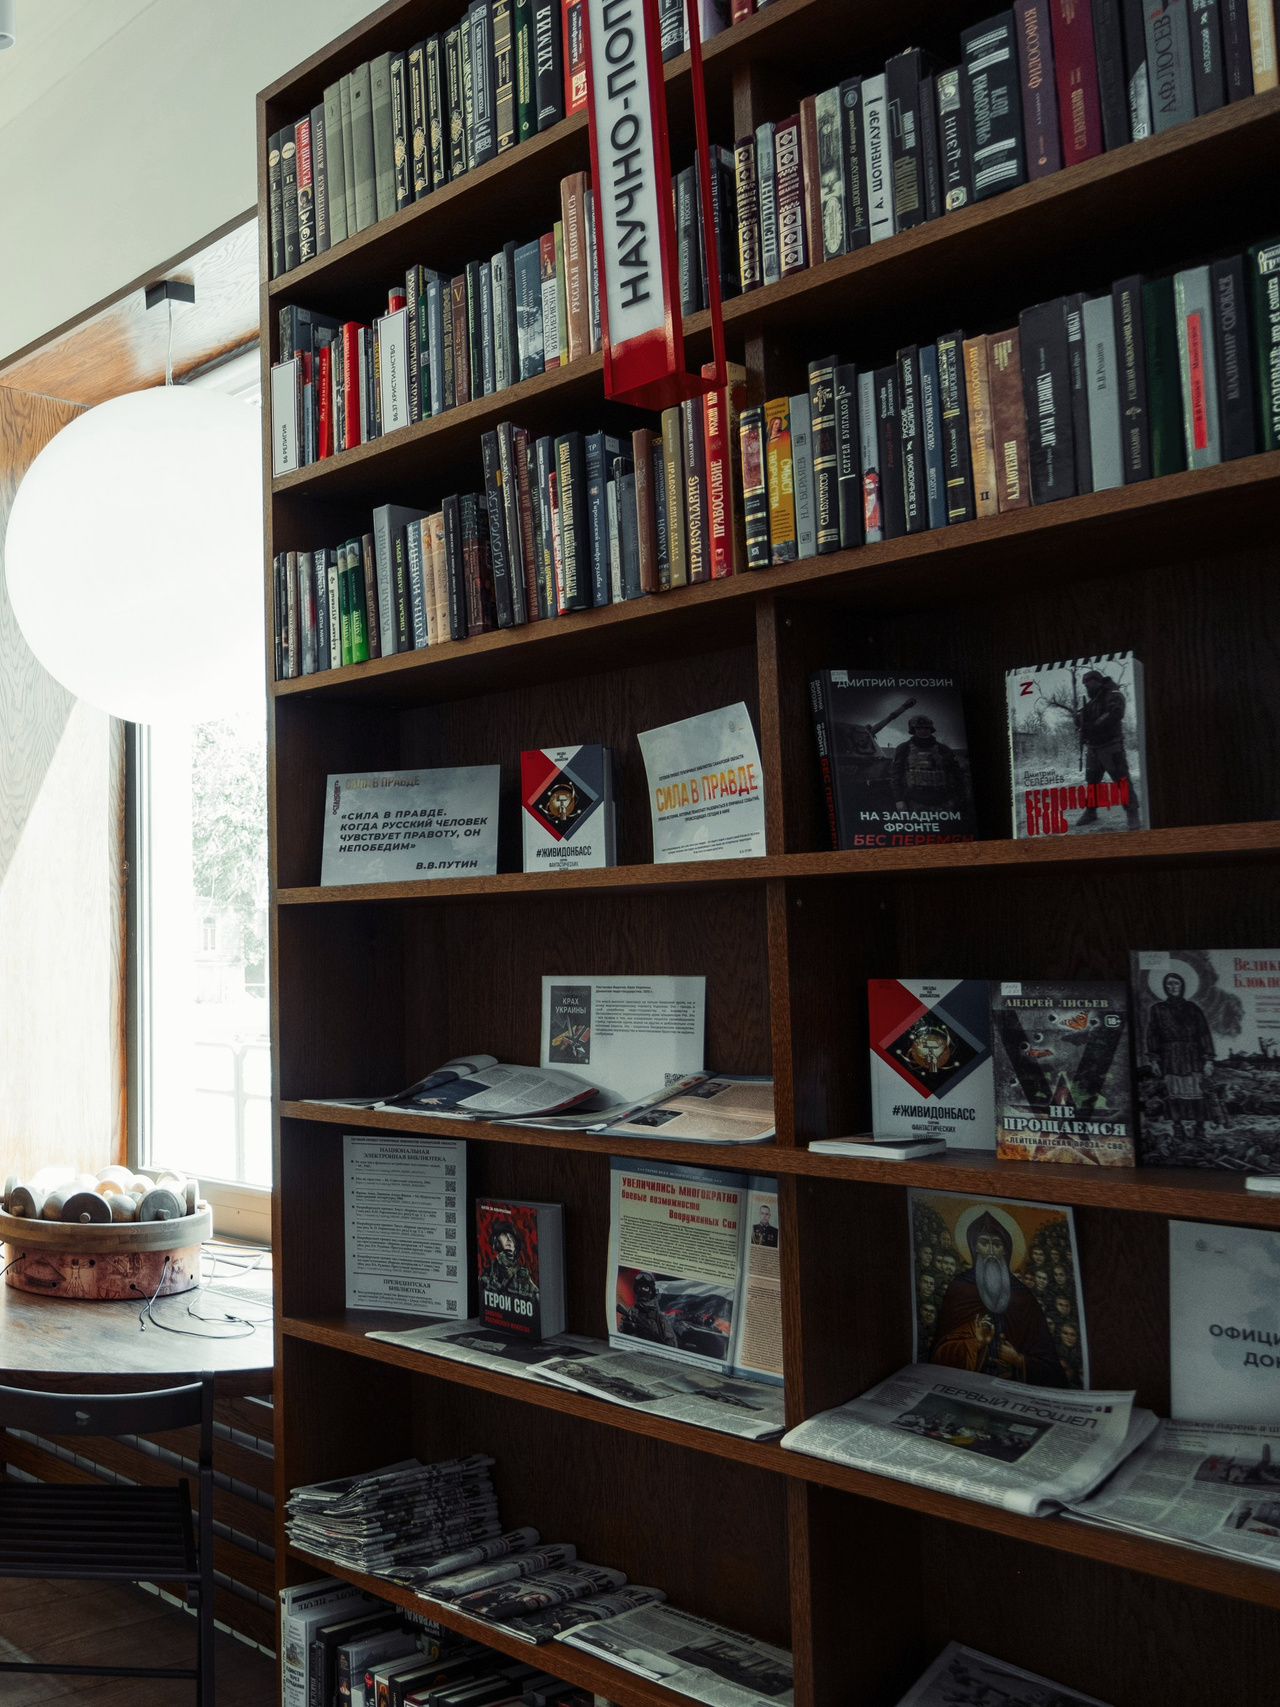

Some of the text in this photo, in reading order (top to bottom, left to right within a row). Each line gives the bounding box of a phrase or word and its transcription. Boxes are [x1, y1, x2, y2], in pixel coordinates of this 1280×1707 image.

[537, 5, 553, 77] ХИМИЯ
[1024, 7, 1043, 89] ФИЛОСОФИЯ
[971, 72, 991, 145] ФИЛОСОФИЯ
[990, 85, 1009, 118] ЙОГИ
[604, 0, 650, 309] НАУЧНО-ПОП
[869, 109, 884, 209] А. ШОПЕНГАУЭР
[944, 115, 962, 183] И-ЦЗИН
[316, 121, 326, 236] ЕВРОПЕЙСКАЯ ЖИВОПИСЬ
[850, 156, 861, 206] ШОПЕНГАУЭР
[760, 179, 775, 255] ШЕЛЛИНГ
[568, 194, 580, 314] РУССКАЯ ИКОНОПИСЬ
[543, 287, 551, 323] ЦАРСТВО
[1267, 276, 1280, 311] contra
[548, 284, 557, 352] ИНКВИЗИЦИЯ:
[1218, 274, 1240, 400] ВЛАДИМИР СОЛОВЬЕВ
[903, 357, 912, 385] ЕВРОПА
[949, 364, 958, 401] МИРОВОЕ
[969, 346, 984, 434] КУРС ФИЛОСОФИИ
[906, 395, 916, 437] МЫСЛИТЕЛИ
[1036, 372, 1057, 447] ЛИСТЫ ДНЕВНИКА
[840, 398, 851, 474] СЕРГЕЙ БУЛГАКОВ
[926, 406, 935, 451] ФИЛОСОФИЯ
[283, 455, 288, 464] 86
[558, 441, 569, 463] РОССИИ
[707, 406, 725, 538] ПРАВОСЛАВИЕ РУССКИЙ
[769, 449, 779, 509] ТВОРЧЕСТВА
[781, 459, 792, 494] СМЫСЛ
[668, 461, 677, 529] ПРАВОСЛАВНАЯ
[489, 490, 505, 577] АСТРОЛОГИЯ
[591, 498, 601, 540] Тирольский
[687, 475, 702, 574] ПРАВОСЛАВИЕ
[657, 518, 667, 560] ХАМОН
[378, 525, 391, 634] ТАЙНАЯ ДОКТРИНА
[411, 542, 423, 643] ТАЙНА ИМЕНИ
[545, 566, 553, 605] РАЗУМНЫЙ
[593, 563, 602, 588] судьбы
[837, 677, 953, 689] ДМИТРИЙ РОГОЗИН
[1020, 681, 1034, 697] Z
[816, 723, 825, 758] ФРОНТЕ
[372, 778, 379, 788] В
[381, 776, 420, 788] ПРАВДЕ
[820, 757, 831, 783] БЕС
[1023, 770, 1056, 780] Дмитрий
[656, 763, 758, 812] СИЛА В ПРАВДЕ
[1025, 777, 1130, 813] БЕСПОКОЯЩИЙ
[340, 817, 488, 831] КОГДА РУССКИЙ ЧЕЛОВЕК
[341, 812, 379, 820] «СИЛА
[395, 809, 447, 818] ПРАВДЕ.
[860, 811, 961, 822] НА ЗАПАДНОМ
[884, 823, 940, 832] ФРОНТЕ
[1026, 809, 1068, 836] ОГОНЬ
[339, 843, 416, 853] НЕПОБЕДИМ»
[340, 829, 481, 842] ЧУВСТВУЕТ ПРАВОТУ, ОН
[536, 846, 592, 858] #ЖИВИДОНБАСС
[853, 834, 975, 846] БЕС ПЕРЕМЕН
[416, 860, 478, 870] В.В.ПУТИН
[1234, 957, 1280, 972] Велик
[555, 1006, 586, 1014] УКРАИНЫ
[562, 997, 579, 1005] КРАХ
[1005, 997, 1109, 1008] АНДРЕЙ ЛИСЬЕВ
[892, 1104, 976, 1121] #ЖИВИДОНБАСС
[911, 1124, 956, 1132] ФАНТАСТИЧЕСКИХ
[1003, 1118, 1127, 1136] ПРОЩАЕМСЯ
[1049, 1105, 1075, 1118] НЕ
[621, 1189, 700, 1211] боевые возможности
[622, 1177, 738, 1204] УВЕЛИЧИЛИСЬ МНОГОКРАТНО
[669, 1209, 737, 1229] Вооруженных Сил
[383, 1278, 431, 1289] ПРЕЗИДЕНТСКАЯ
[388, 1286, 426, 1295] БИБЛИОТЕКА
[484, 1290, 534, 1317] ГЕРОИ СВО
[1244, 1352, 1280, 1368] ДО
[931, 1383, 1098, 1429] ПЕРВЫЙ ПРОШЕЛ
